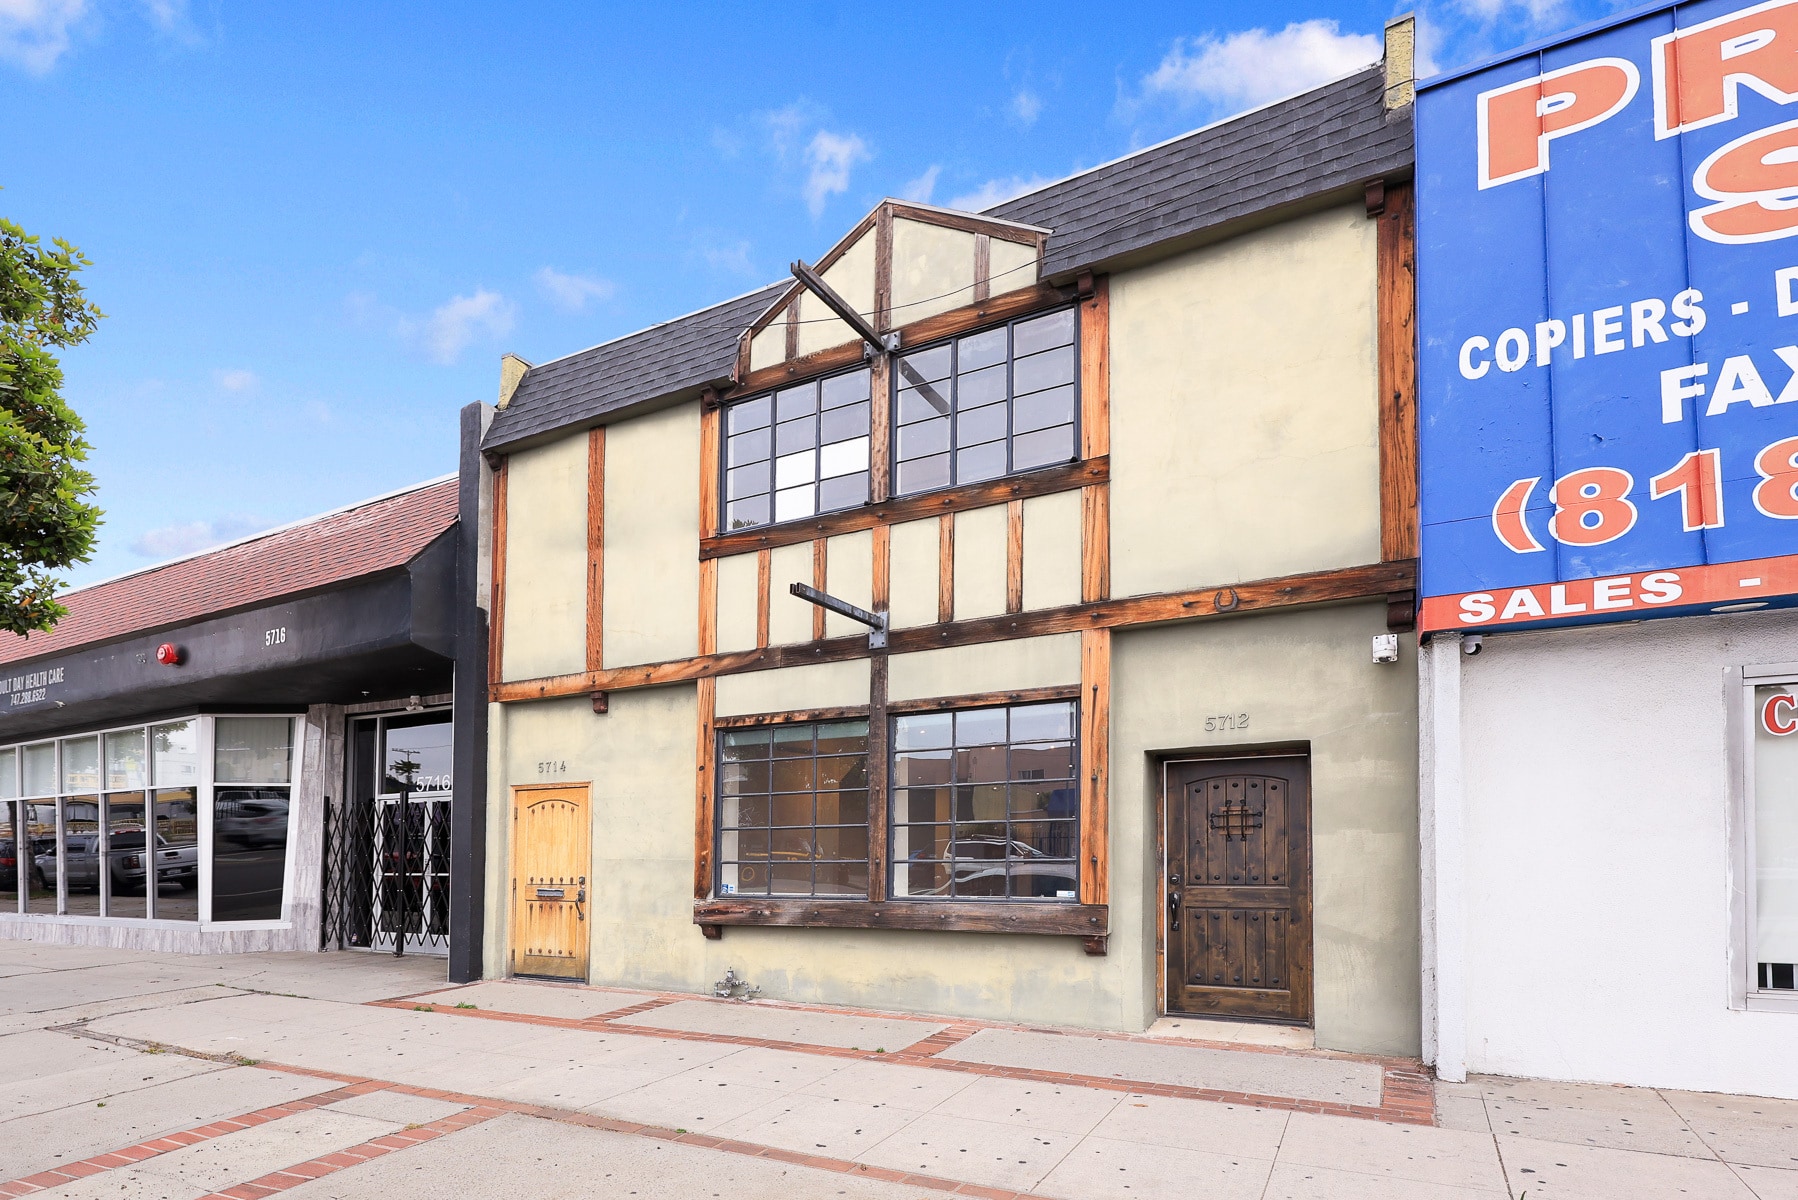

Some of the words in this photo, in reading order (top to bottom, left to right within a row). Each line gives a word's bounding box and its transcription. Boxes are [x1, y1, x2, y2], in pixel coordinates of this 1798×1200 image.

[1477, 0, 1798, 190] PR
[1458, 287, 1707, 380] COPIERS
[1458, 572, 1683, 624] SALES
[265, 626, 286, 646] 5716
[12, 675, 25, 692] DAY
[25, 670, 48, 690] HEALTH
[48, 667, 65, 685] CARE
[1204, 712, 1250, 732] 5712
[538, 760, 567, 774] 5714
[416, 774, 451, 792] 5716
